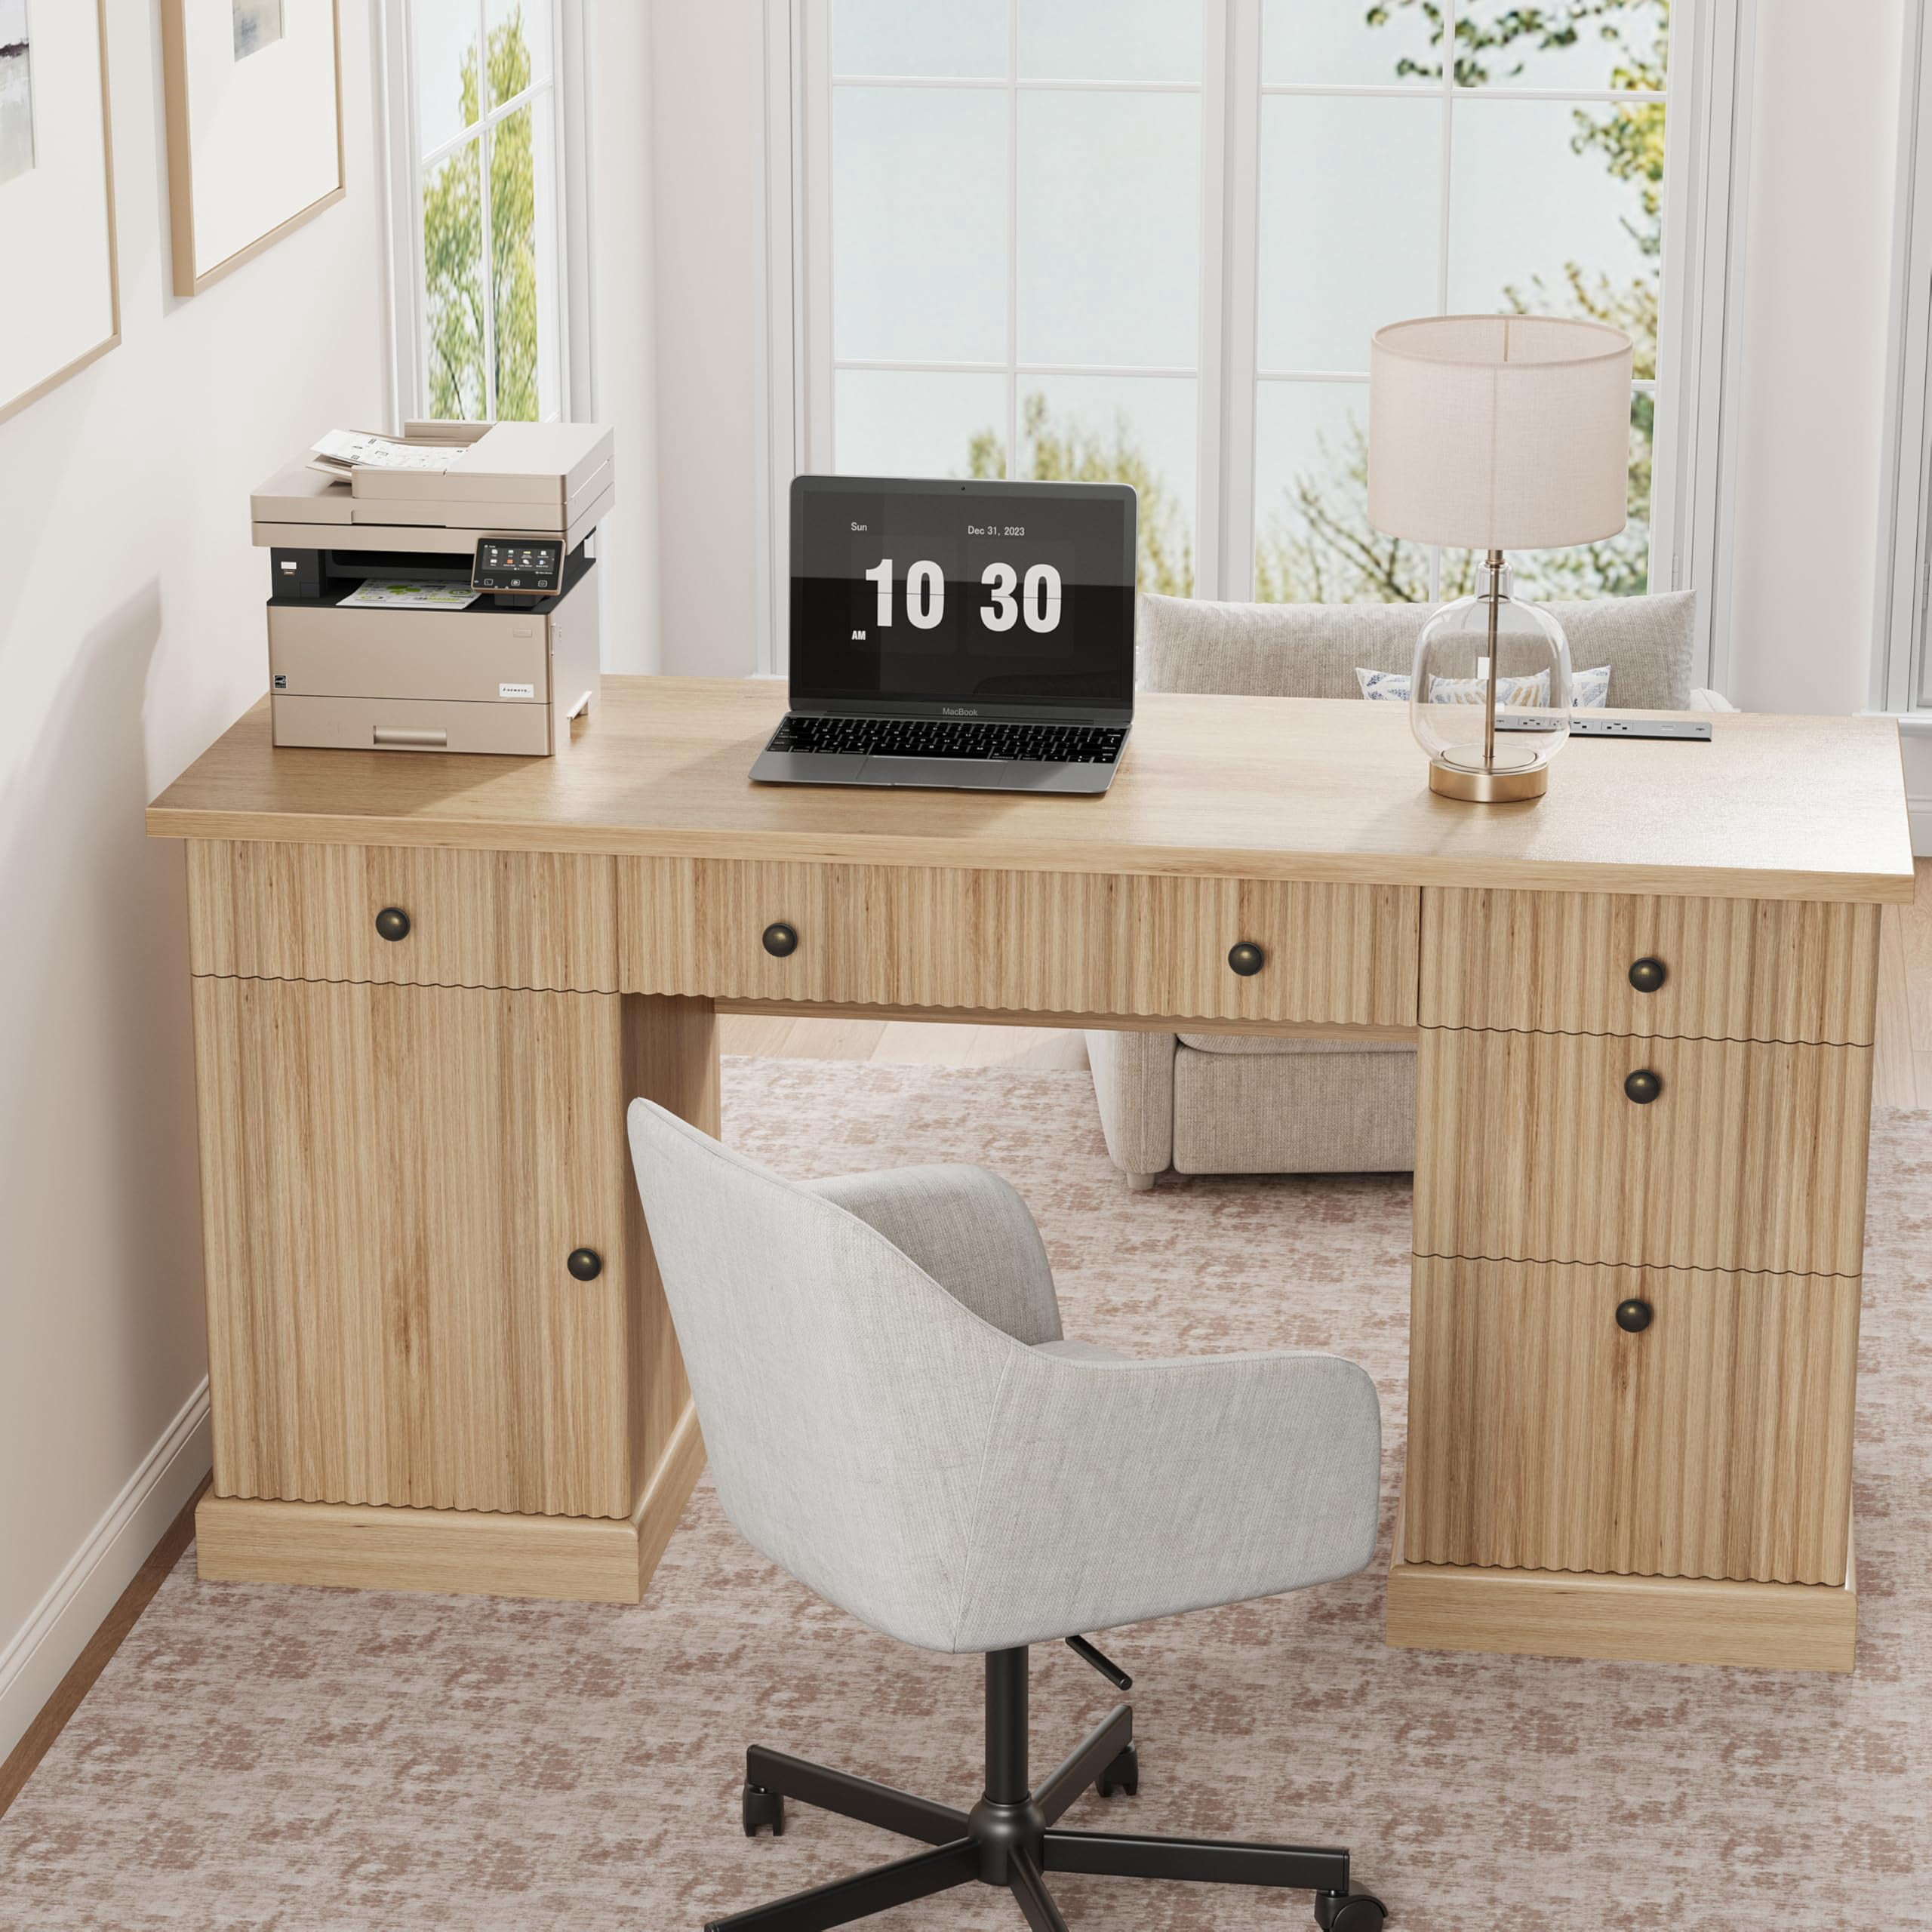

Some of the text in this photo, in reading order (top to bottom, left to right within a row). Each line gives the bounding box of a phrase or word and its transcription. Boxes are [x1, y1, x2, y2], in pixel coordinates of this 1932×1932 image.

[851, 522, 867, 531] Sun
[968, 525, 1025, 536] Dec 31, 2023
[866, 558, 1062, 633] 10 30
[851, 630, 866, 641] AM
[943, 707, 978, 716] MacBook
